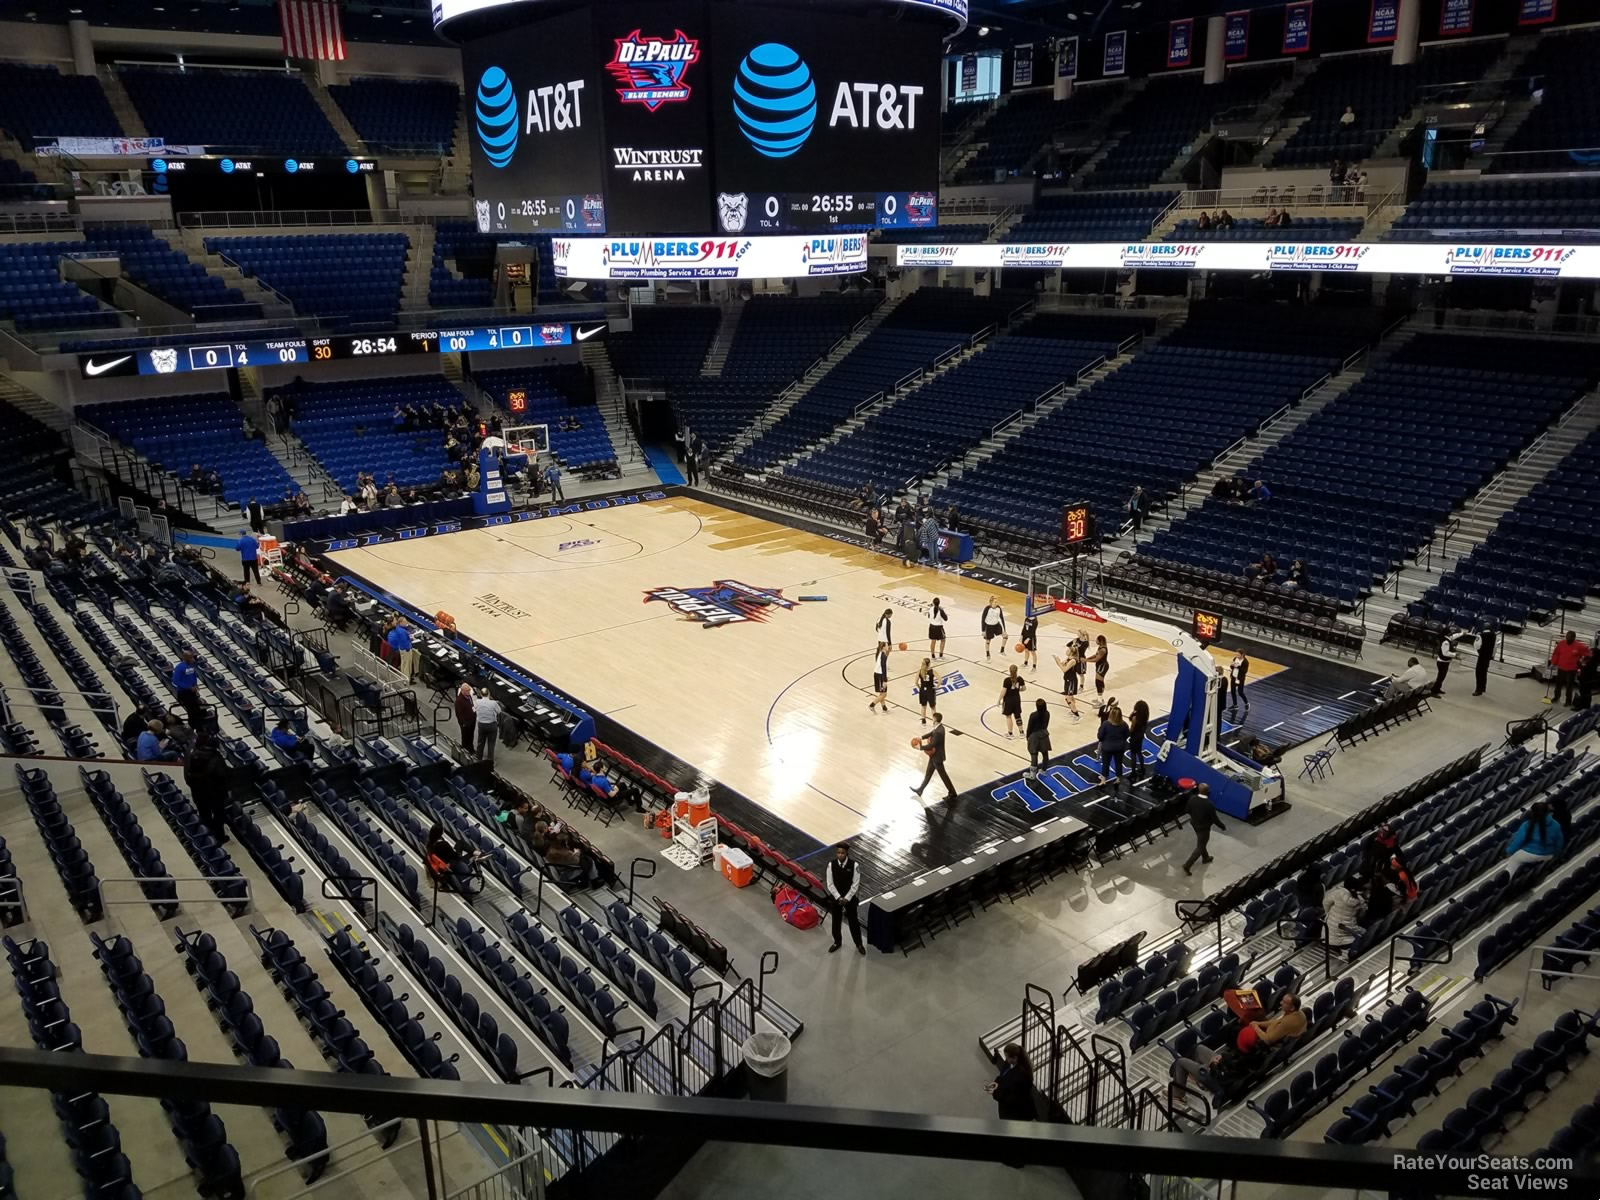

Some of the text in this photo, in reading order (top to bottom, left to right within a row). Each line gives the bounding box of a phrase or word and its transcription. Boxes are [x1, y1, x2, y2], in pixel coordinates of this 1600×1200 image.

[1375, 8, 1395, 17] NCAA
[1288, 20, 1306, 29] NCAA
[1170, 48, 1188, 58] 1945
[627, 90, 685, 99] BLUE DEMONS
[526, 79, 585, 135] AT&T
[829, 81, 924, 129] AT&T
[613, 148, 703, 164] WINTRUST
[632, 170, 685, 181] ARENA
[521, 200, 547, 216] 26:55
[566, 199, 575, 219] 0
[765, 196, 779, 217] 0
[811, 195, 853, 212] 26:55
[884, 195, 897, 216] 0
[497, 202, 505, 220] 0
[829, 215, 838, 223] 1st
[611, 268, 736, 277] Emergency Plumbing Service 1-Click Away
[810, 265, 833, 273] Emergency
[411, 331, 437, 340] PERIOD
[489, 335, 498, 347] 4
[512, 331, 521, 345] 0
[285, 340, 306, 348] FOULS
[352, 337, 396, 355] 26:54
[422, 340, 428, 352] 1
[450, 338, 466, 350] 00
[206, 350, 217, 365] 0
[237, 351, 248, 365] 4
[279, 348, 296, 362] 00
[315, 346, 331, 359] 30
[512, 399, 524, 409] 30
[324, 490, 667, 552] BLUE DEMONS
[1067, 508, 1086, 521] 26:54
[1070, 520, 1084, 538] 30
[472, 602, 502, 618] ARENA
[480, 592, 532, 619] WINTRUST
[1196, 613, 1218, 625] 26:54
[1201, 624, 1213, 636] 30
